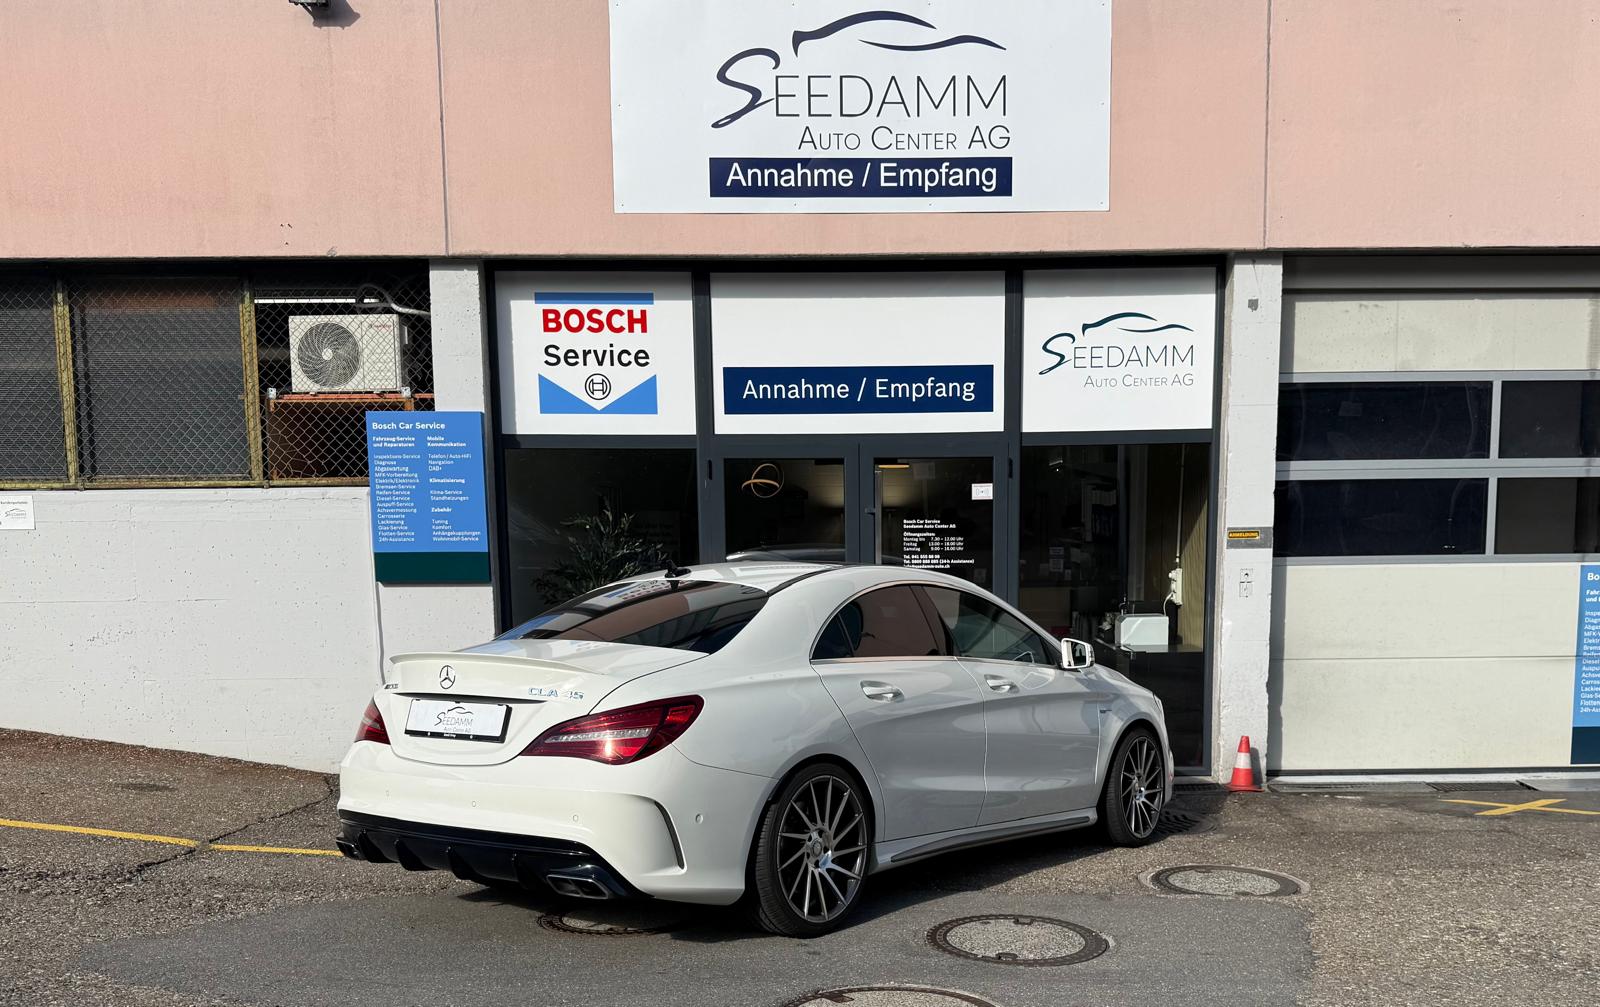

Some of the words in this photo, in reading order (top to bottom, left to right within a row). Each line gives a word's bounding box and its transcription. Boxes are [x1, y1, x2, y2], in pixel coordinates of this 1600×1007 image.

[711, 48, 1007, 128] SEEDAMM
[968, 125, 1010, 150] AG
[726, 163, 854, 188] Annahme
[862, 163, 870, 188] /
[880, 162, 998, 192] Empfang
[542, 308, 648, 334] BOSCH
[544, 344, 650, 366] Service
[1038, 332, 1194, 376] SEEDAMM
[742, 378, 850, 399] Annahme
[857, 378, 866, 402] /
[875, 376, 976, 402] Empfang
[1171, 374, 1194, 386] AG
[528, 688, 559, 697] CLA
[434, 712, 473, 726] SEEDAMM
